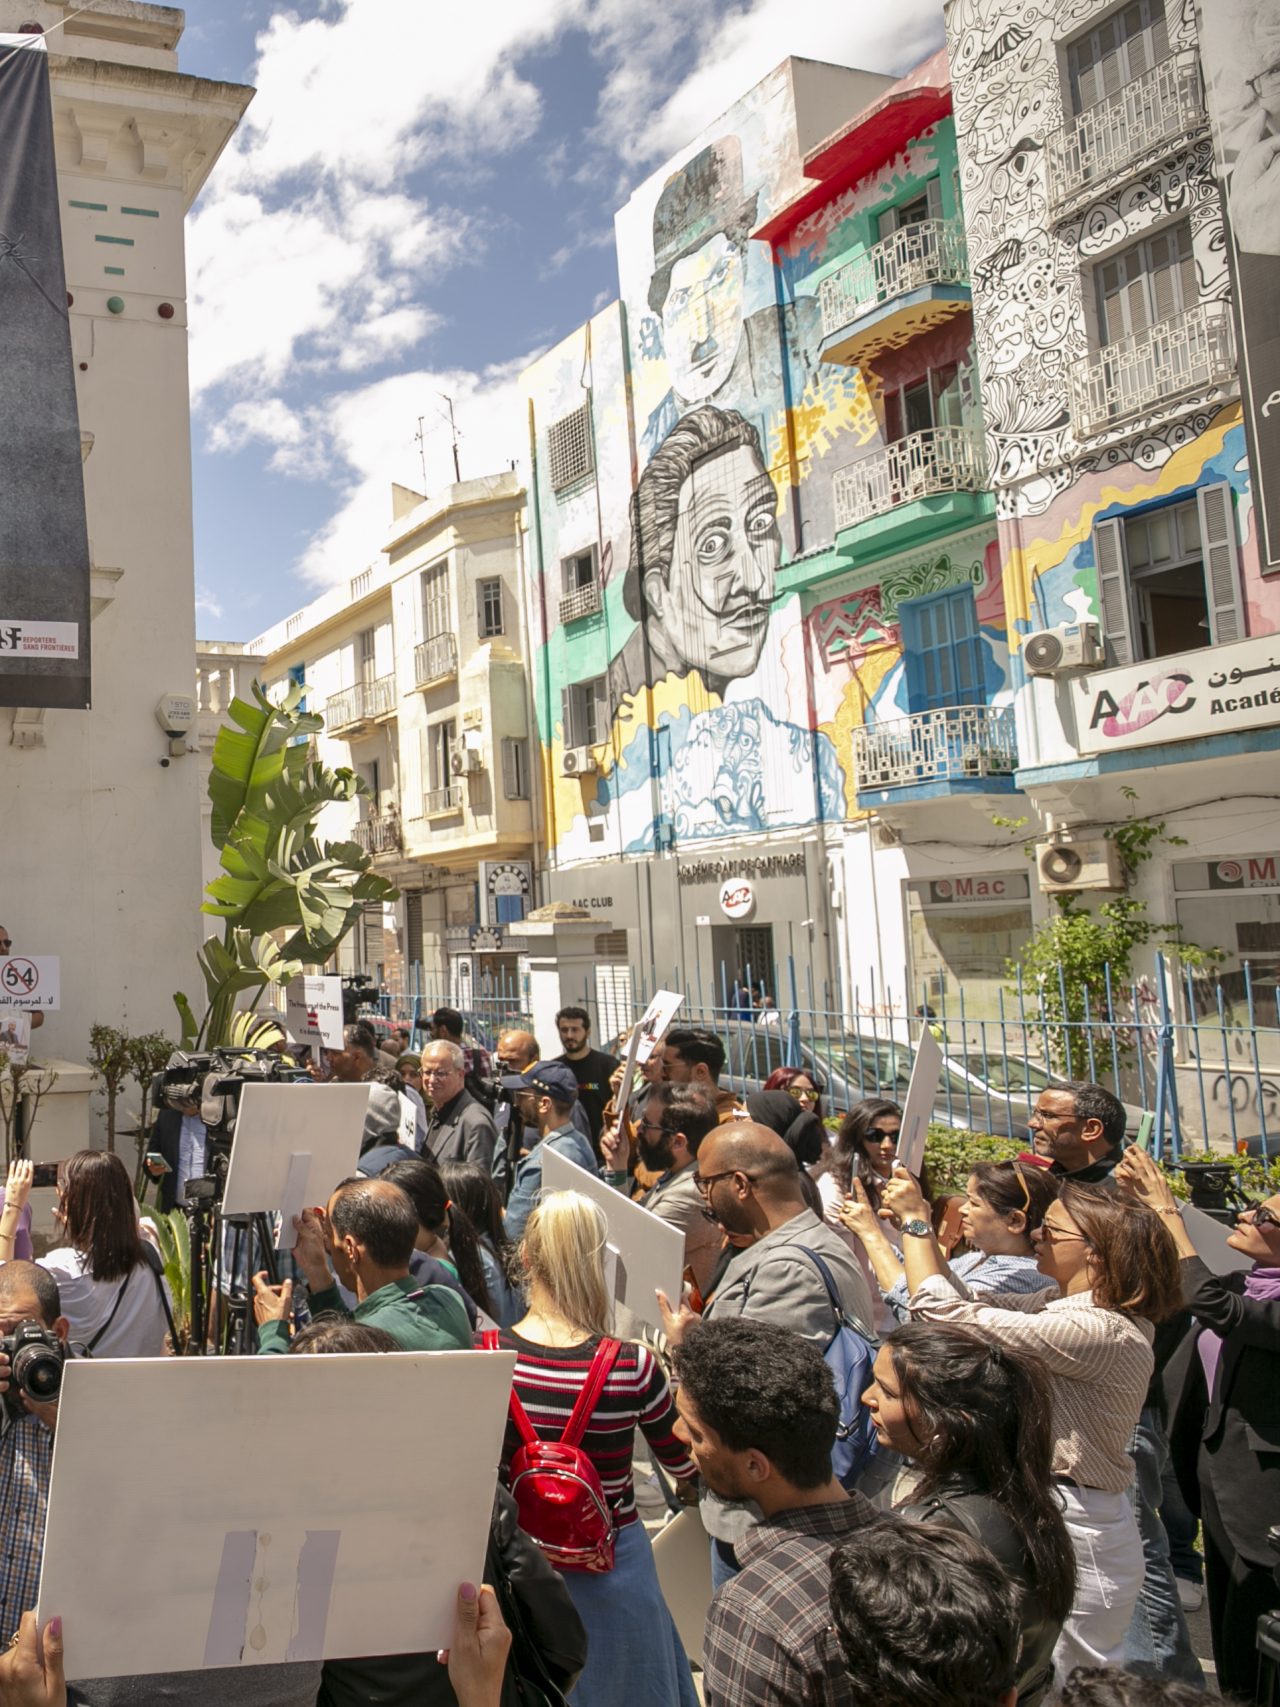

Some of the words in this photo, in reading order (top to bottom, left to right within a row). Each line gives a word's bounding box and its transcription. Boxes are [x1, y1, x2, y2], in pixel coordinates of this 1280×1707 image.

[22, 636, 57, 644] REPORTERS
[22, 643, 39, 651] SANS
[955, 878, 1005, 896] Mac
[591, 897, 613, 908] CLUB
[6, 967, 34, 987] 54
[327, 1003, 339, 1011] Press
